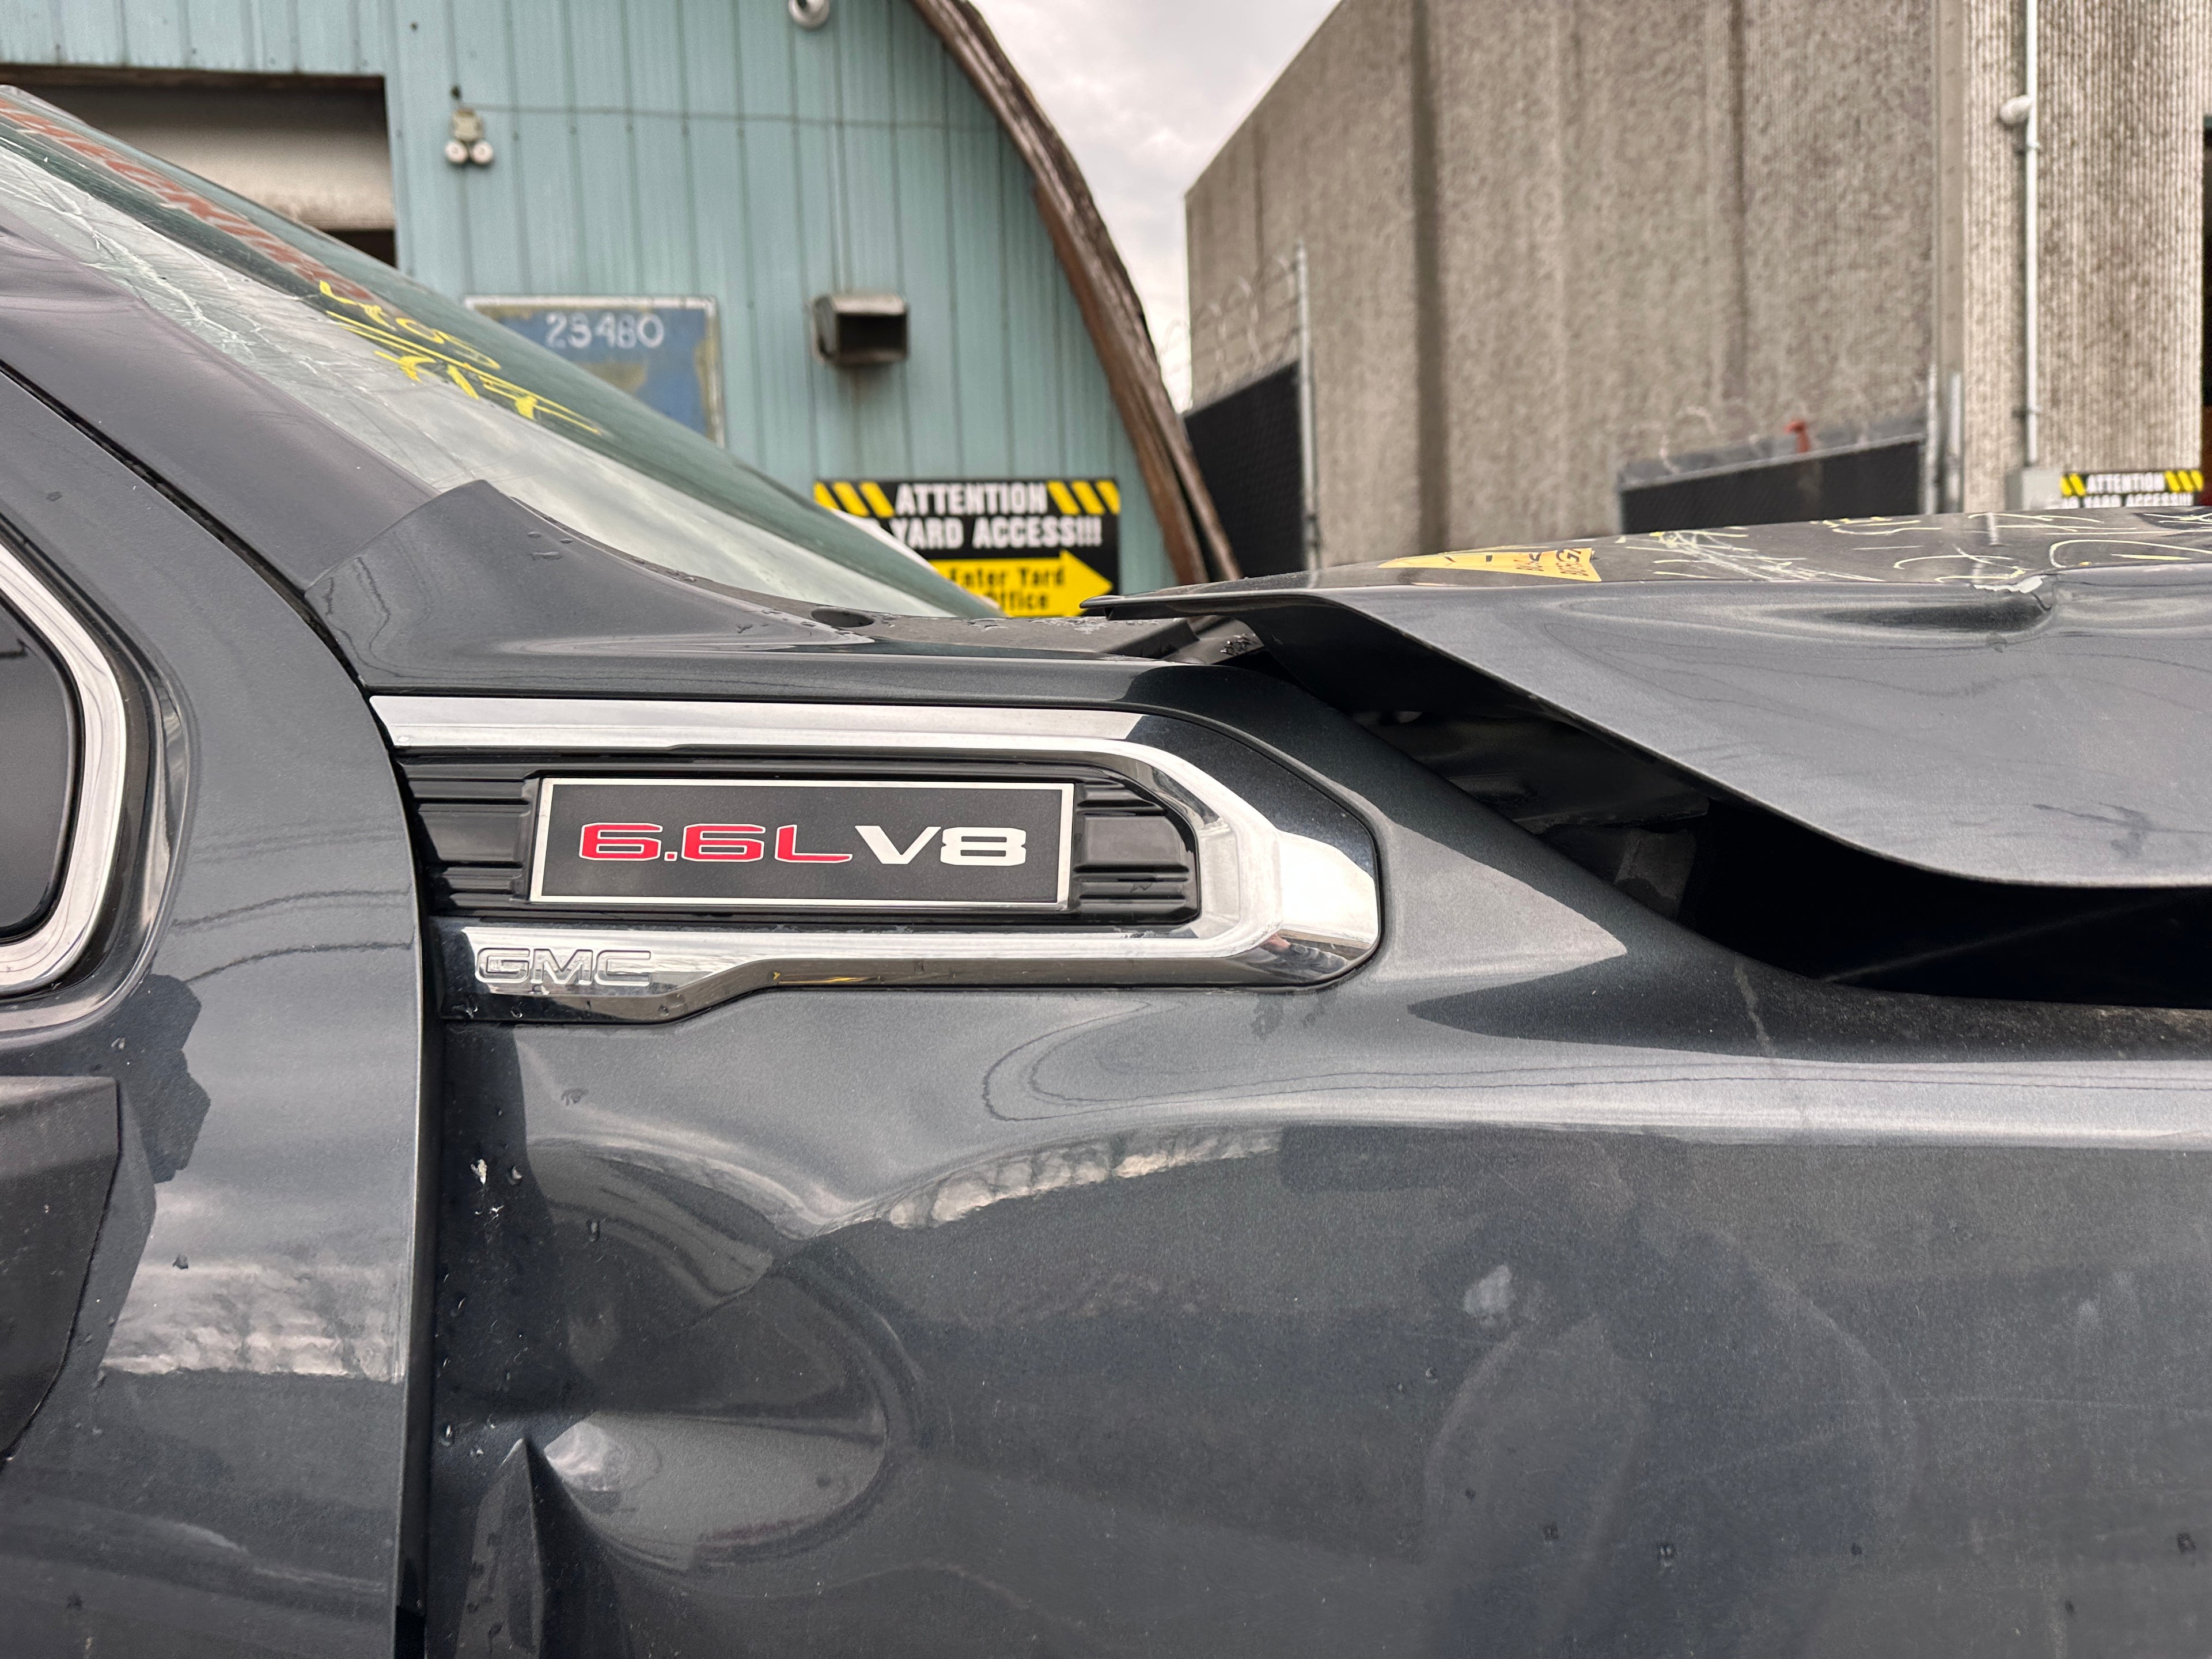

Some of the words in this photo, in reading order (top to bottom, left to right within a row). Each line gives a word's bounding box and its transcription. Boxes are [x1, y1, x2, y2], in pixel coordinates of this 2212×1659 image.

[895, 482, 1048, 516] ATTENTION
[2086, 472, 2165, 494] ATTENTION
[888, 517, 964, 549] YARD
[972, 516, 1103, 547] ACCESS!!!
[949, 566, 1007, 589] Enter
[1018, 566, 1065, 587] Yard
[578, 822, 854, 864] 6.6L
[854, 825, 1028, 867] V8
[475, 948, 653, 987] GMC
